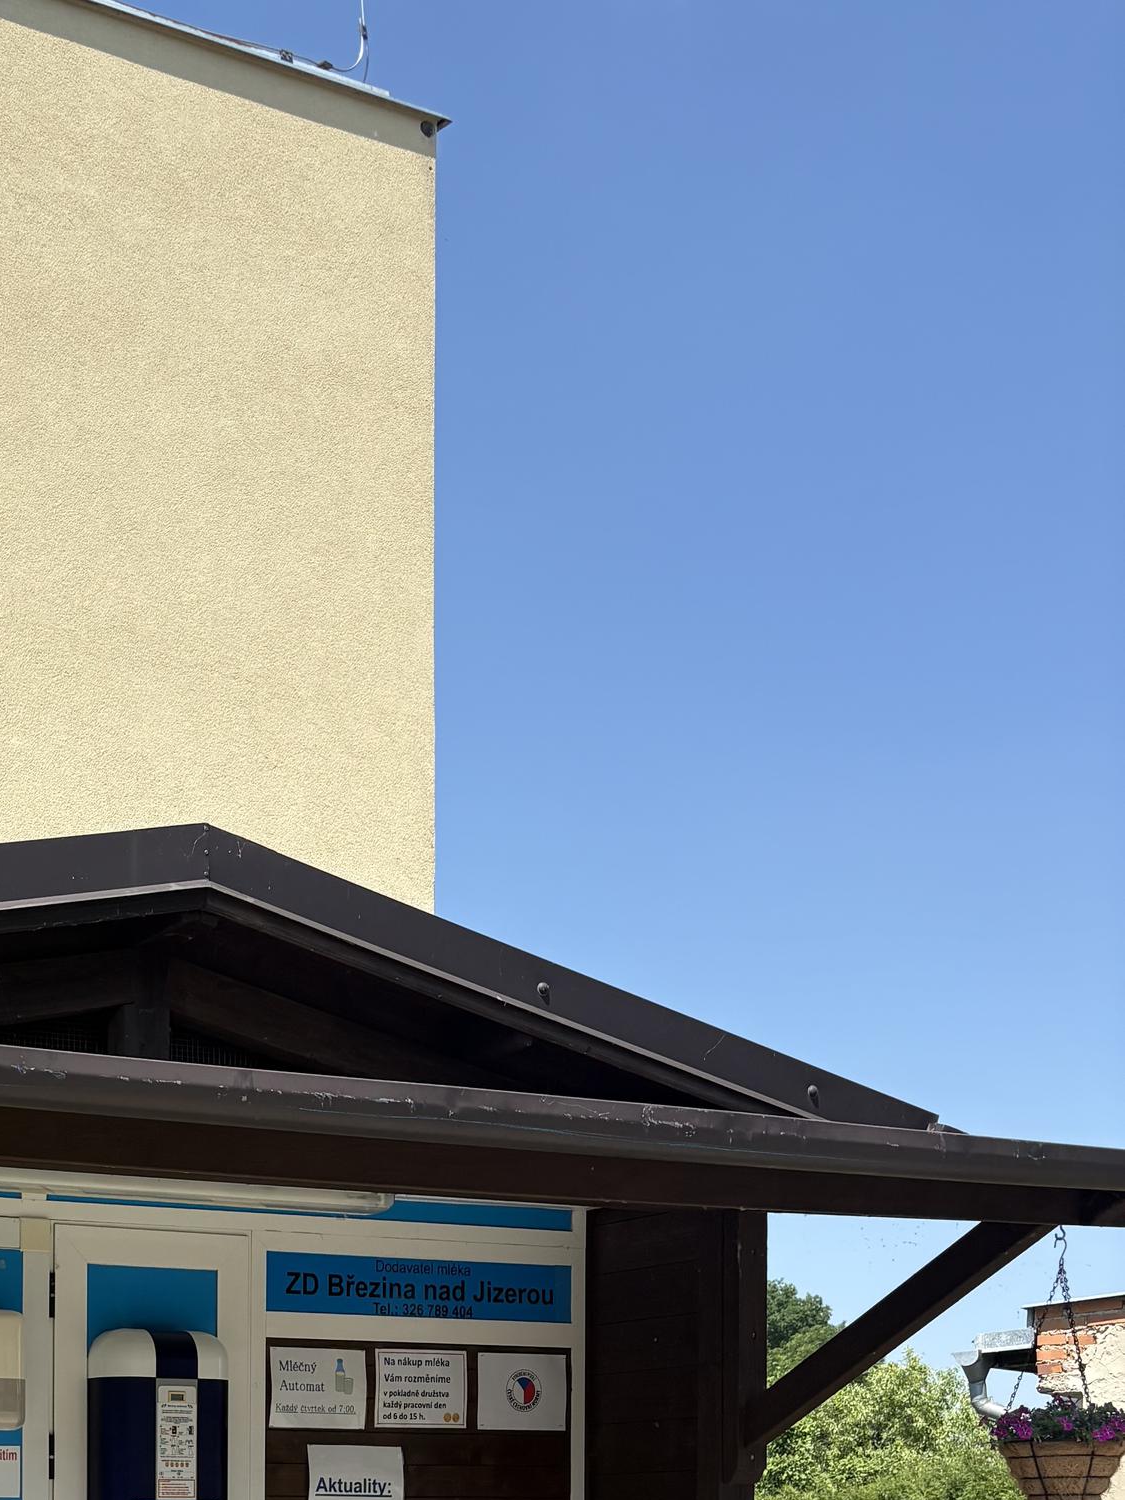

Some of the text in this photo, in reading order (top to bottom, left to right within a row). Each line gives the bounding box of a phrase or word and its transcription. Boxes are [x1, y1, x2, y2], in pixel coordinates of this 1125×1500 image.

[375, 1260, 471, 1277] Dodavatel mléka
[285, 1272, 553, 1305] ZD Březina nad Jizerou
[374, 1303, 474, 1317] Tel.: 326 789 404
[279, 1360, 317, 1374] Mléčný
[397, 1358, 422, 1368] nákup
[425, 1358, 450, 1367] mléka
[384, 1374, 451, 1383] Vám rozměníme
[279, 1380, 325, 1392] Automat
[389, 1390, 419, 1398] pokladně
[383, 1401, 402, 1409] každý
[404, 1402, 433, 1410] pracovní
[315, 1477, 393, 1497] Aktuality:
